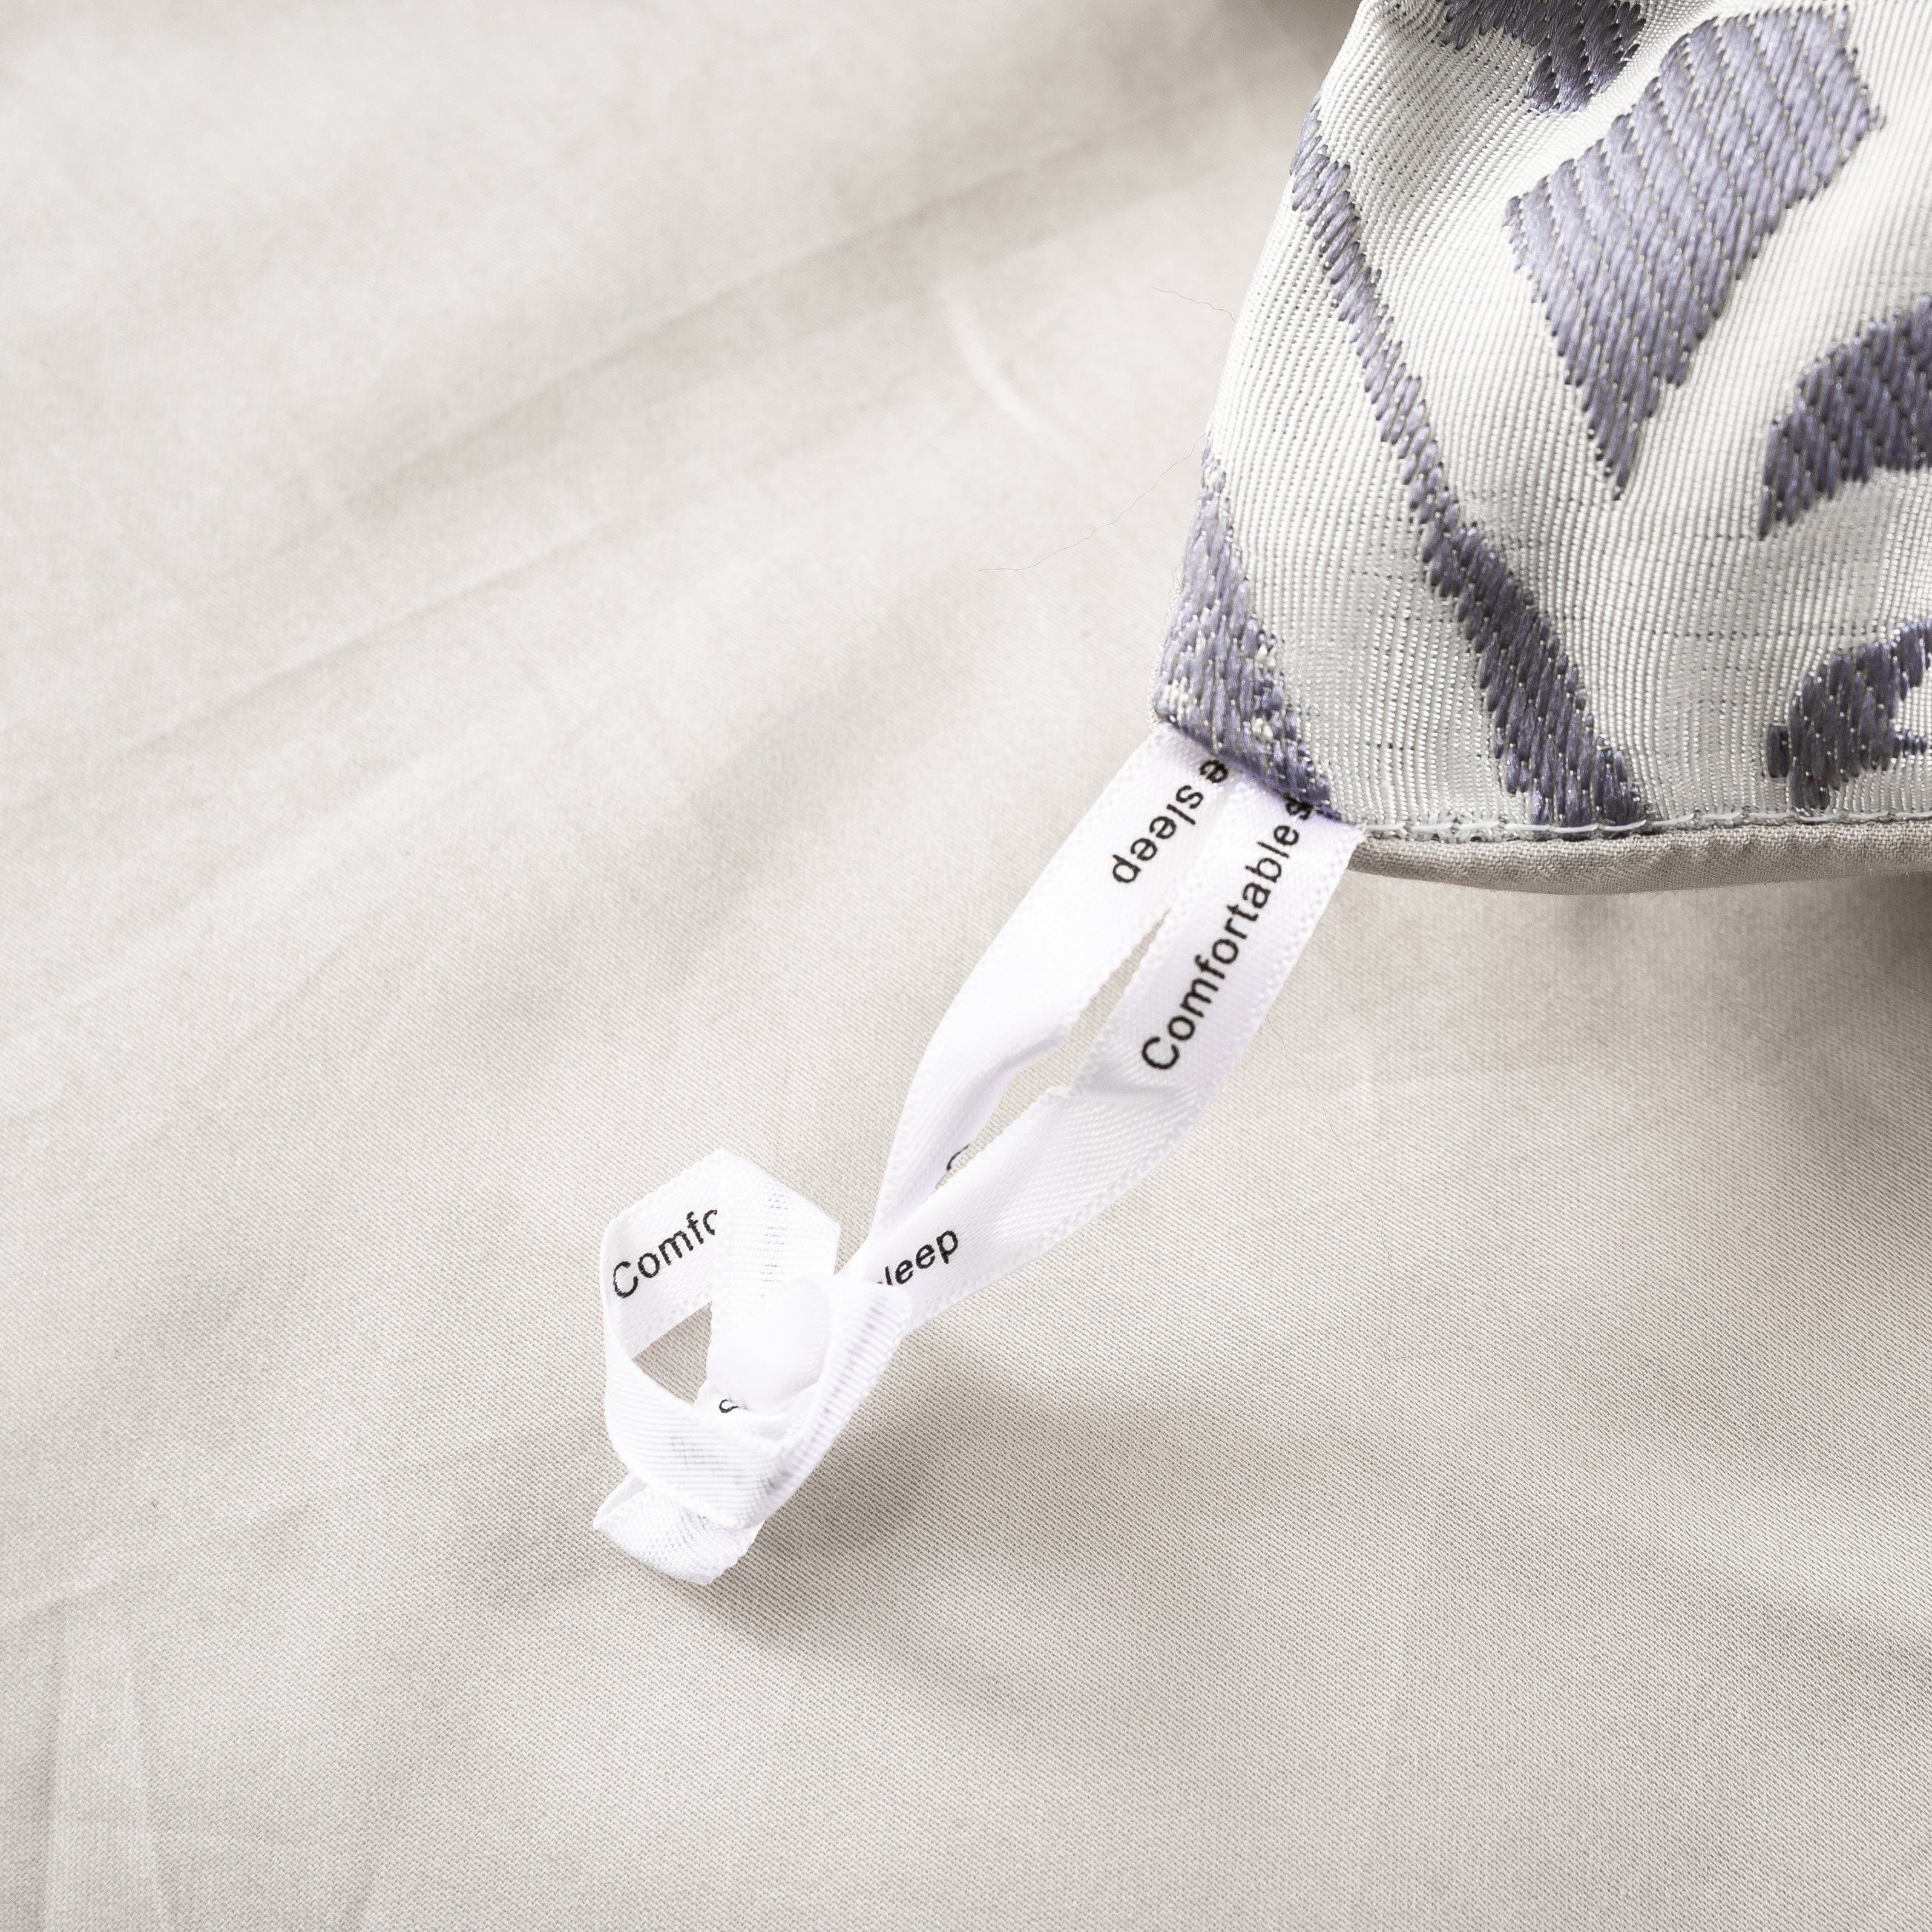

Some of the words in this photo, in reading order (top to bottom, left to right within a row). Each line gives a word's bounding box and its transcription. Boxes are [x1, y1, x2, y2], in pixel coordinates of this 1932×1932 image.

[1113, 786, 1203, 883] sleep
[1142, 826, 1299, 1070] Comfortable
[878, 1230, 958, 1285] leep
